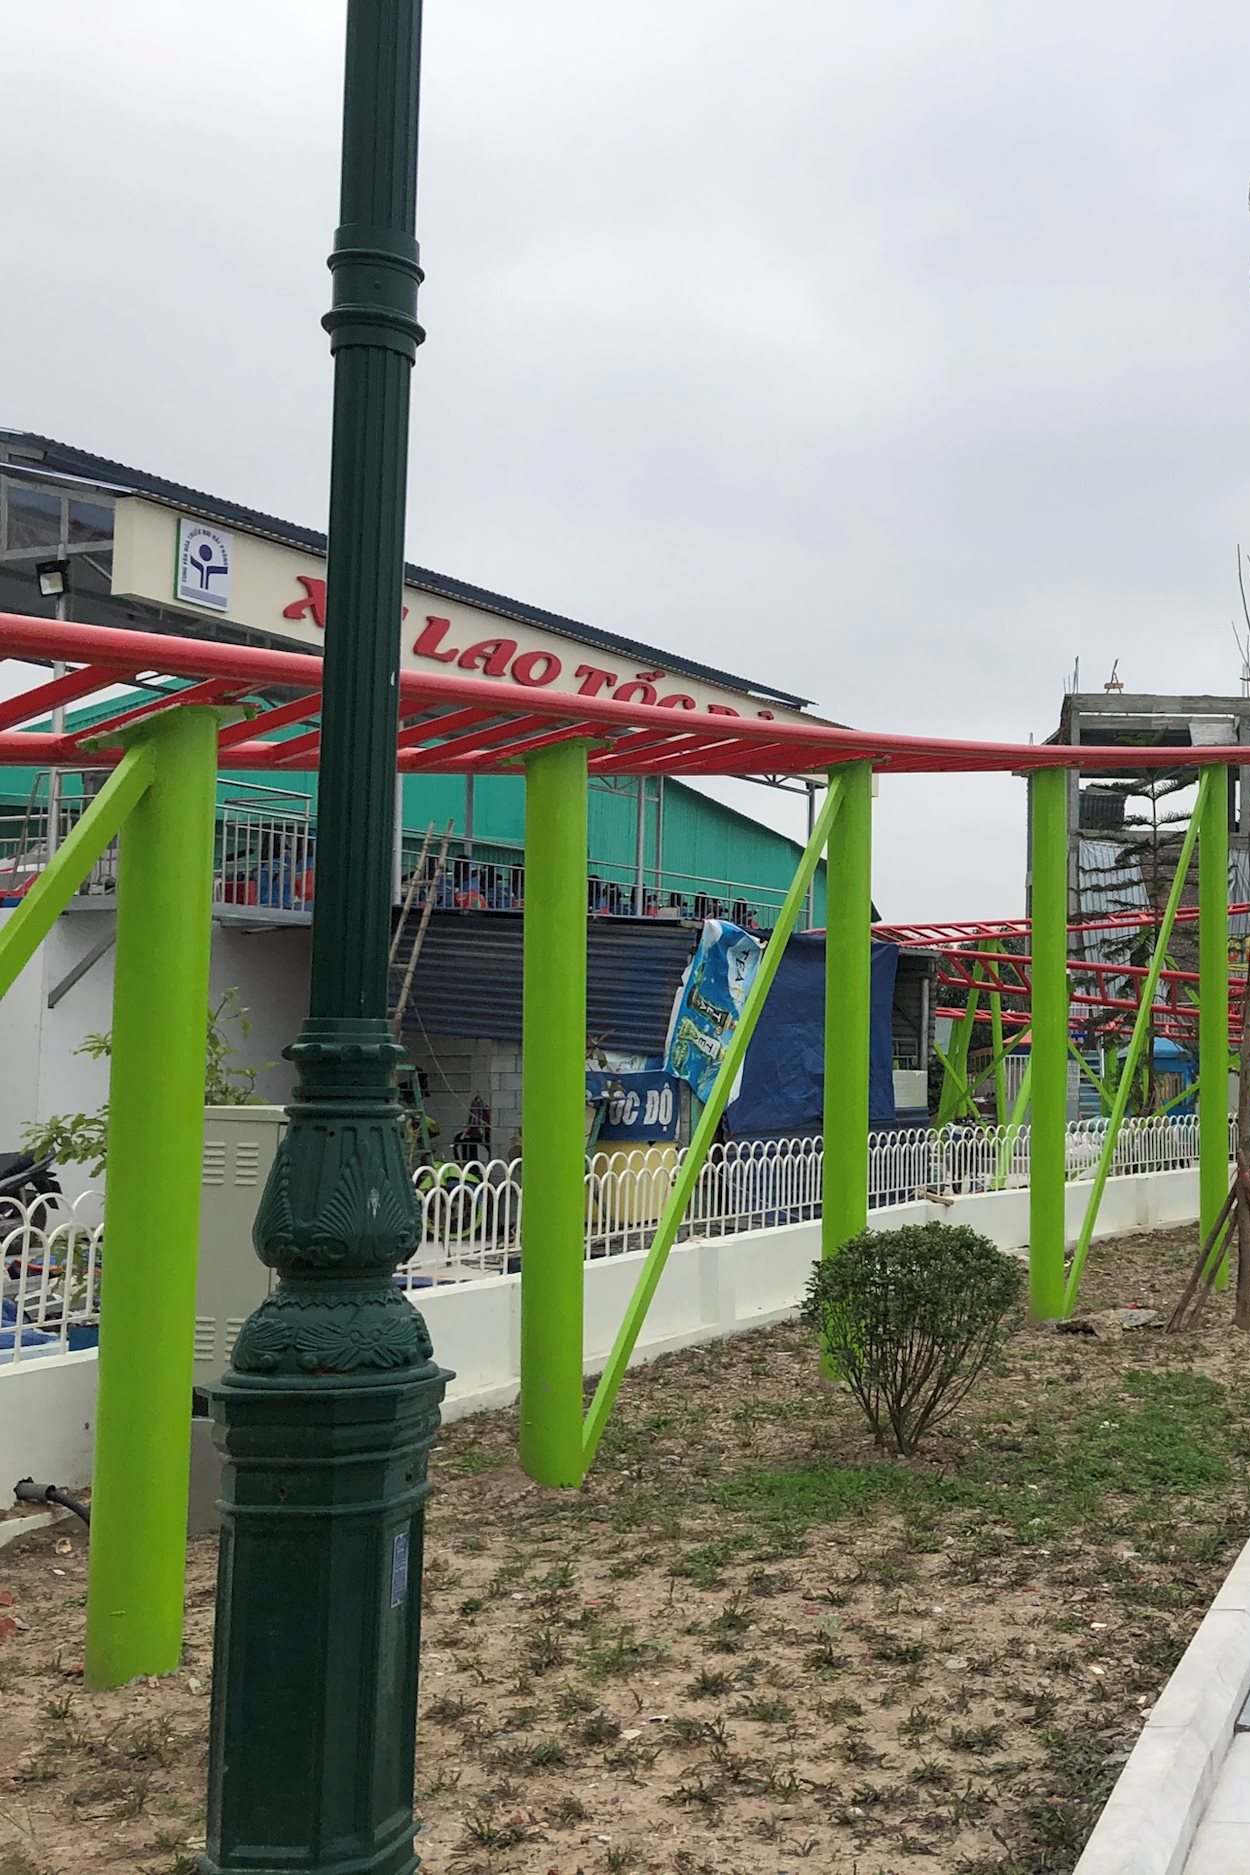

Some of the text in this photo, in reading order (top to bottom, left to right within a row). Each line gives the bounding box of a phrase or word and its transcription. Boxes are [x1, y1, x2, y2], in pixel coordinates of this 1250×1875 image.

[413, 615, 562, 688] LAO
[735, 949, 750, 982] TEA
[643, 1081, 673, 1132] ĐỘ
